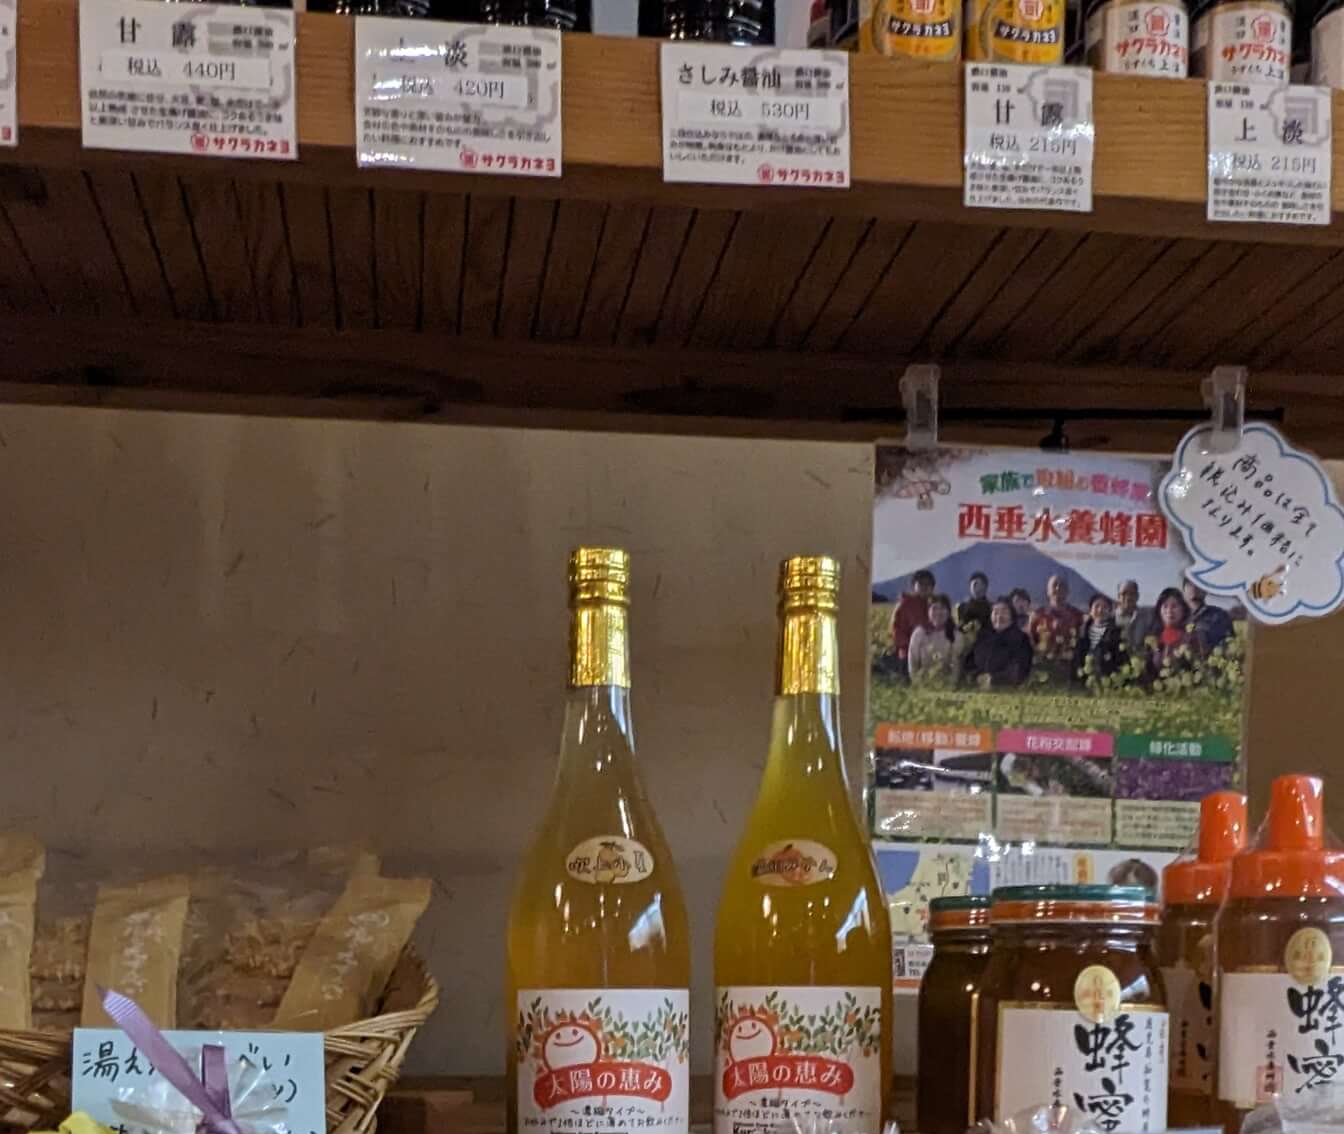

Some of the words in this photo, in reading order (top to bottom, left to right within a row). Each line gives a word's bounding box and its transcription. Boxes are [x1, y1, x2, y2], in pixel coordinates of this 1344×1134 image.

[127, 56, 162, 78] 税込
[182, 60, 236, 81] 440円
[678, 62, 782, 89] さしみ醤油
[454, 79, 505, 99] 420円
[710, 98, 743, 118] 税込
[760, 101, 810, 121] 530円
[212, 137, 290, 155] サクラカネヨ
[989, 133, 1020, 151] 税込
[481, 154, 556, 172] サクラカネヨ
[777, 169, 845, 184] サクラカネヨ
[958, 501, 1168, 550] 西垂水養蜂園
[548, 1067, 663, 1099] 太陽の恵み
[732, 1060, 843, 1088] 太陽の恵み
